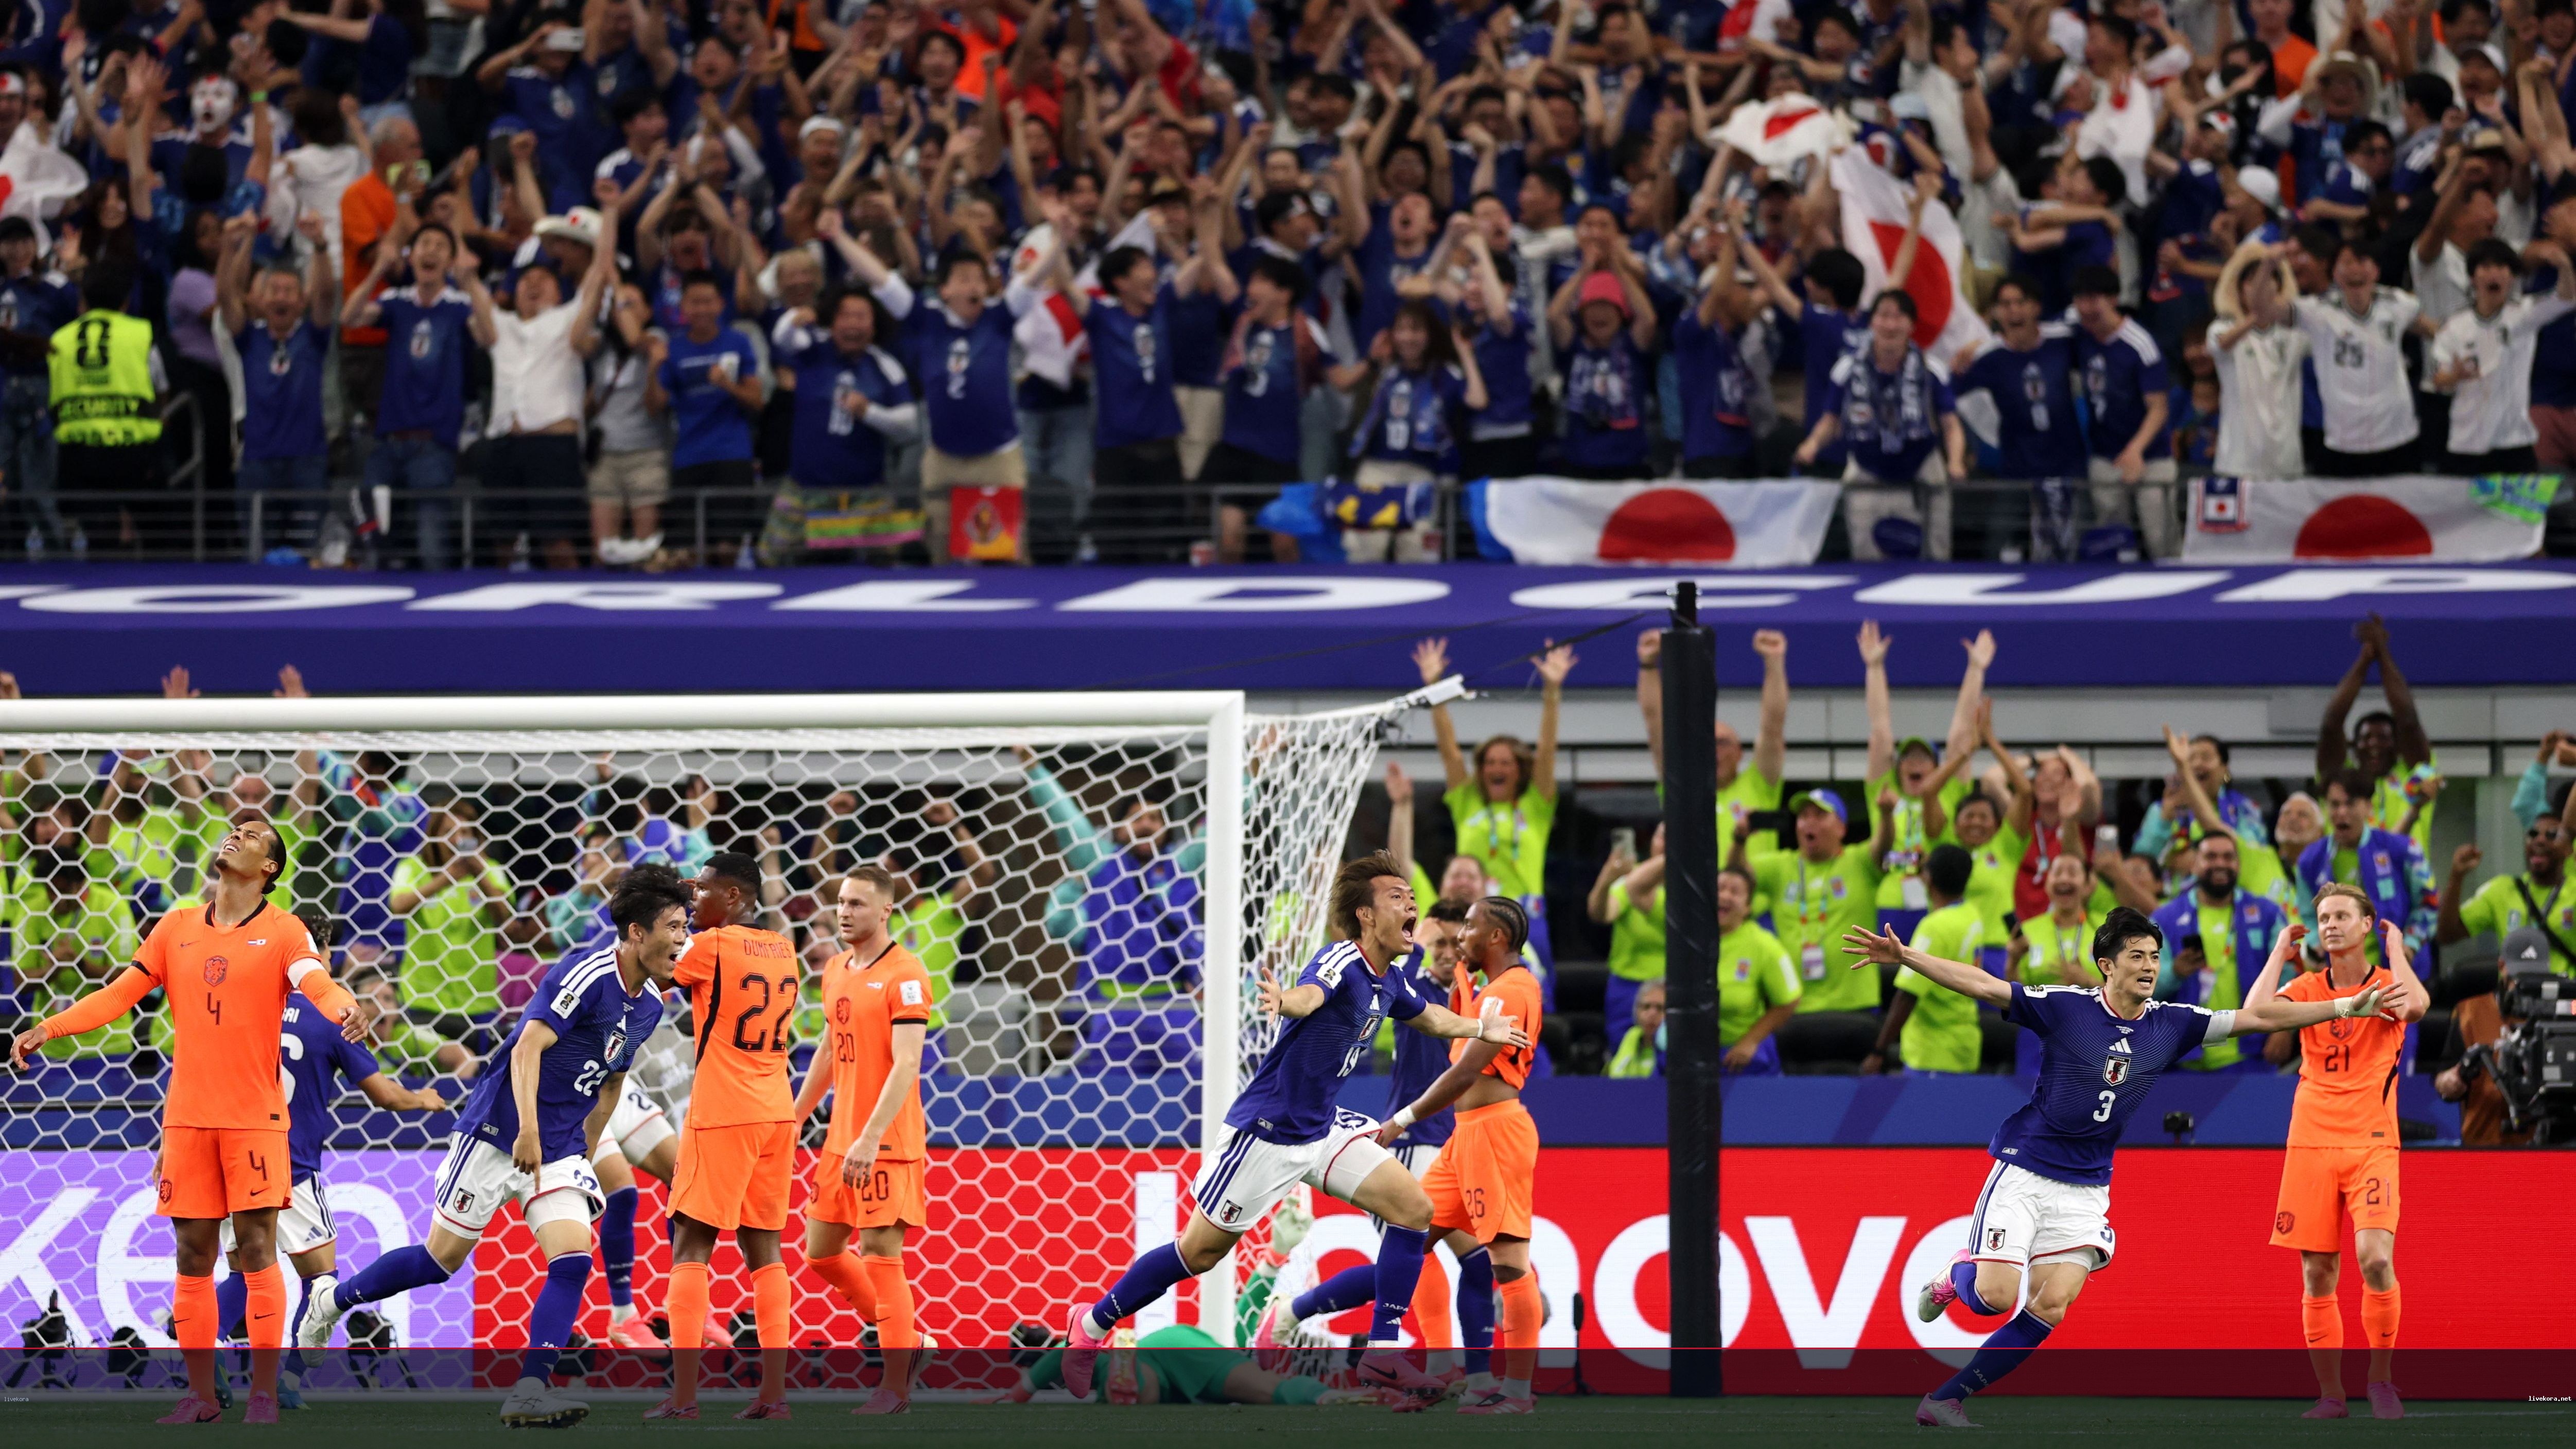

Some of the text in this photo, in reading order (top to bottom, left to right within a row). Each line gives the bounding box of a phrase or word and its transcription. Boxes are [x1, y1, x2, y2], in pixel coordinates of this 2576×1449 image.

[0, 579, 1451, 613] ORLD
[744, 939, 792, 959] DUMFRIES
[207, 992, 221, 1025] 4
[282, 1007, 301, 1024] AI
[732, 972, 799, 1053] 22
[837, 1032, 855, 1063] 20
[1336, 1046, 1360, 1077] 19
[2325, 1045, 2350, 1073] 21
[573, 1059, 608, 1097] 22
[2093, 1090, 2116, 1123] 3
[249, 1150, 268, 1181] 4
[861, 1170, 889, 1202] 20
[2366, 1178, 2390, 1207] 21
[1466, 1188, 1485, 1219] 26
[1973, 1368, 1989, 1386] JAP
